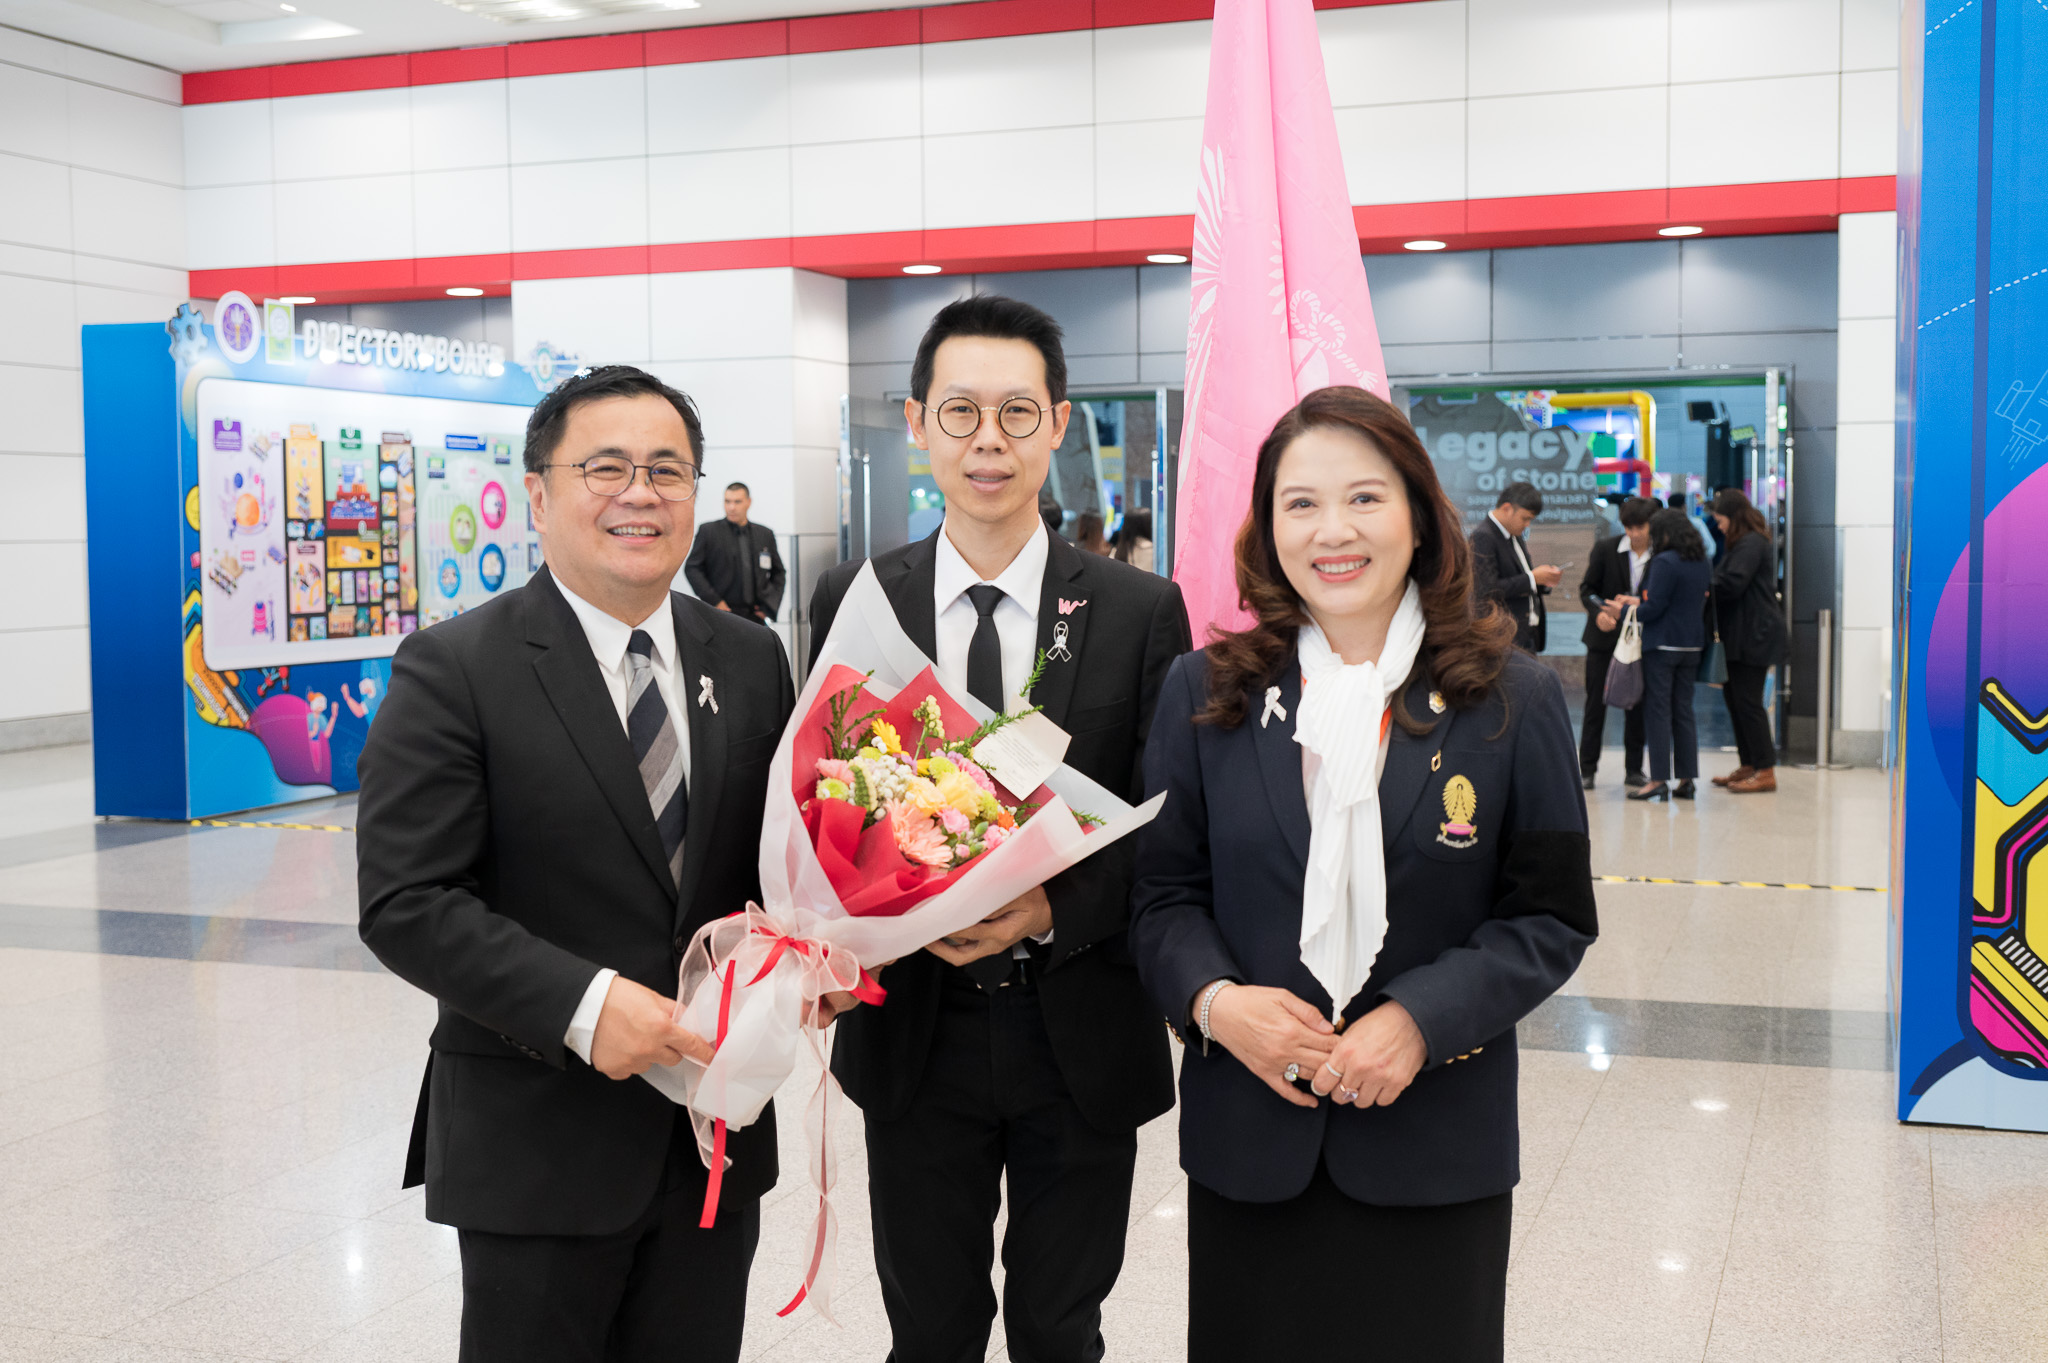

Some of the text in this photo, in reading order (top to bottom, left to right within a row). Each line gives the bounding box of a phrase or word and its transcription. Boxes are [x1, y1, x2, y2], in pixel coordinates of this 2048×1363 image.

[302, 318, 434, 371] DIRECTORY
[1477, 467, 1597, 491] of Stone
